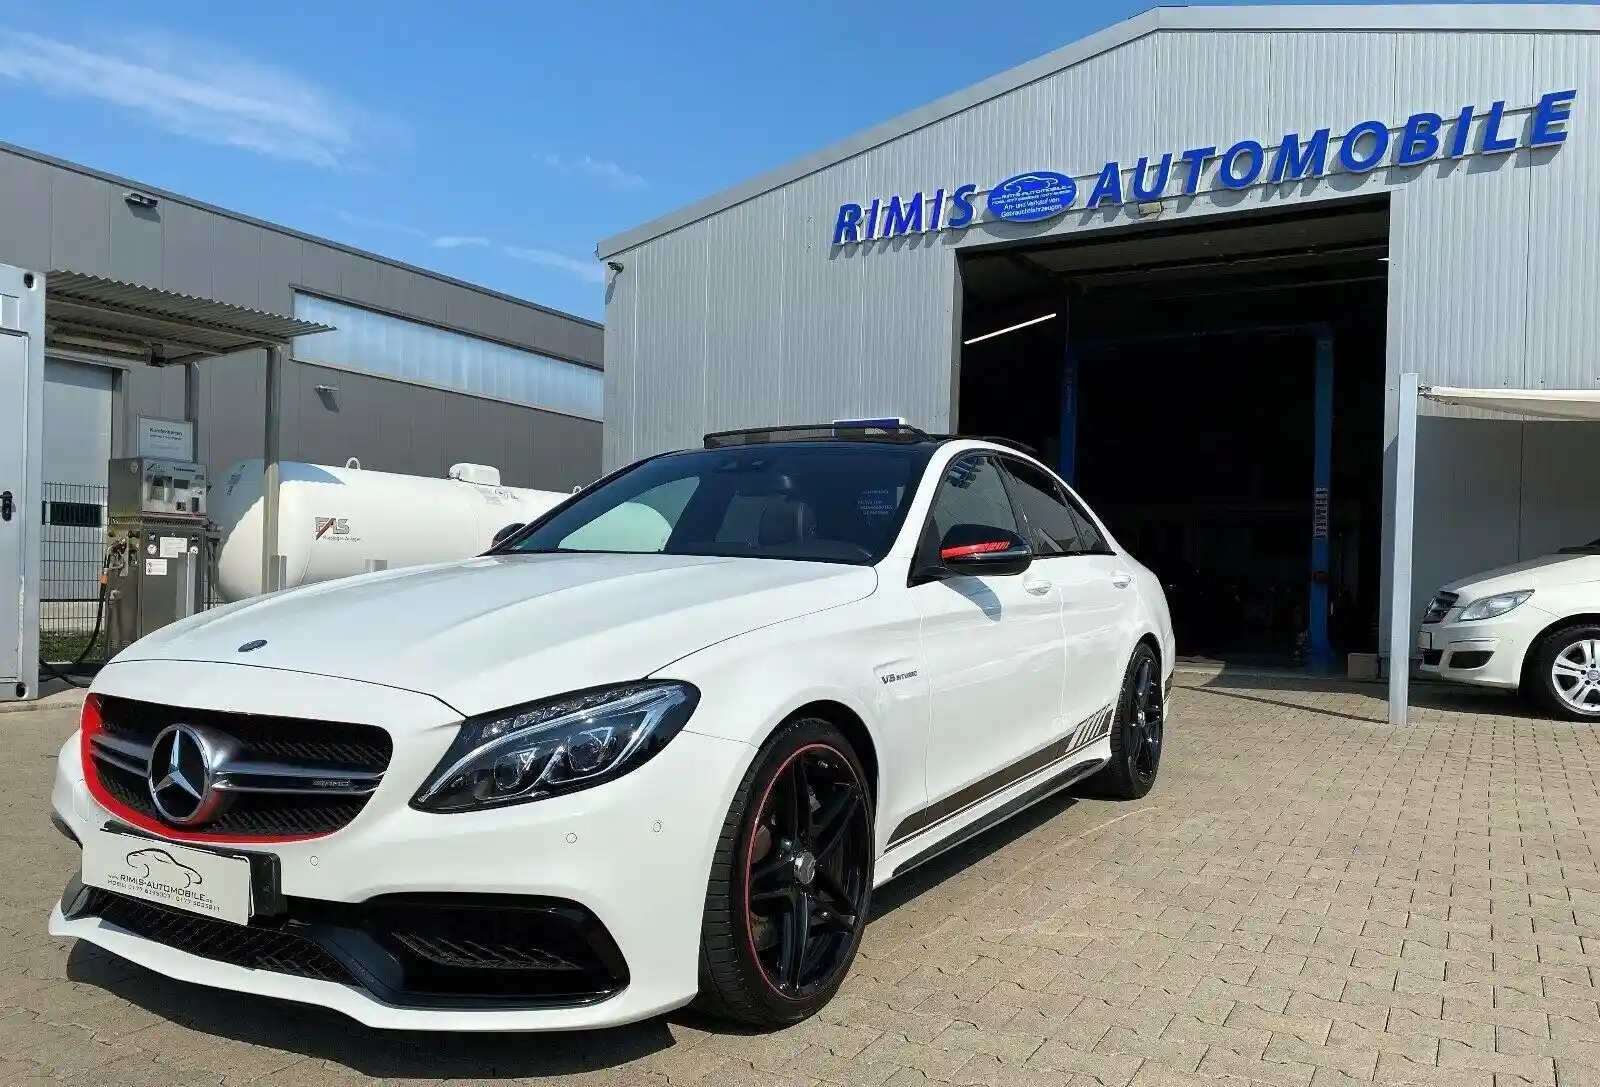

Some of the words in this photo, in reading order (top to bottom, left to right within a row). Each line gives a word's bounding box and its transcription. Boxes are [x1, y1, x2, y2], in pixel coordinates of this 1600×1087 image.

[833, 183, 976, 244] RIMIS
[1087, 89, 1577, 209] AUTOMOBILE
[315, 516, 349, 541] FAS
